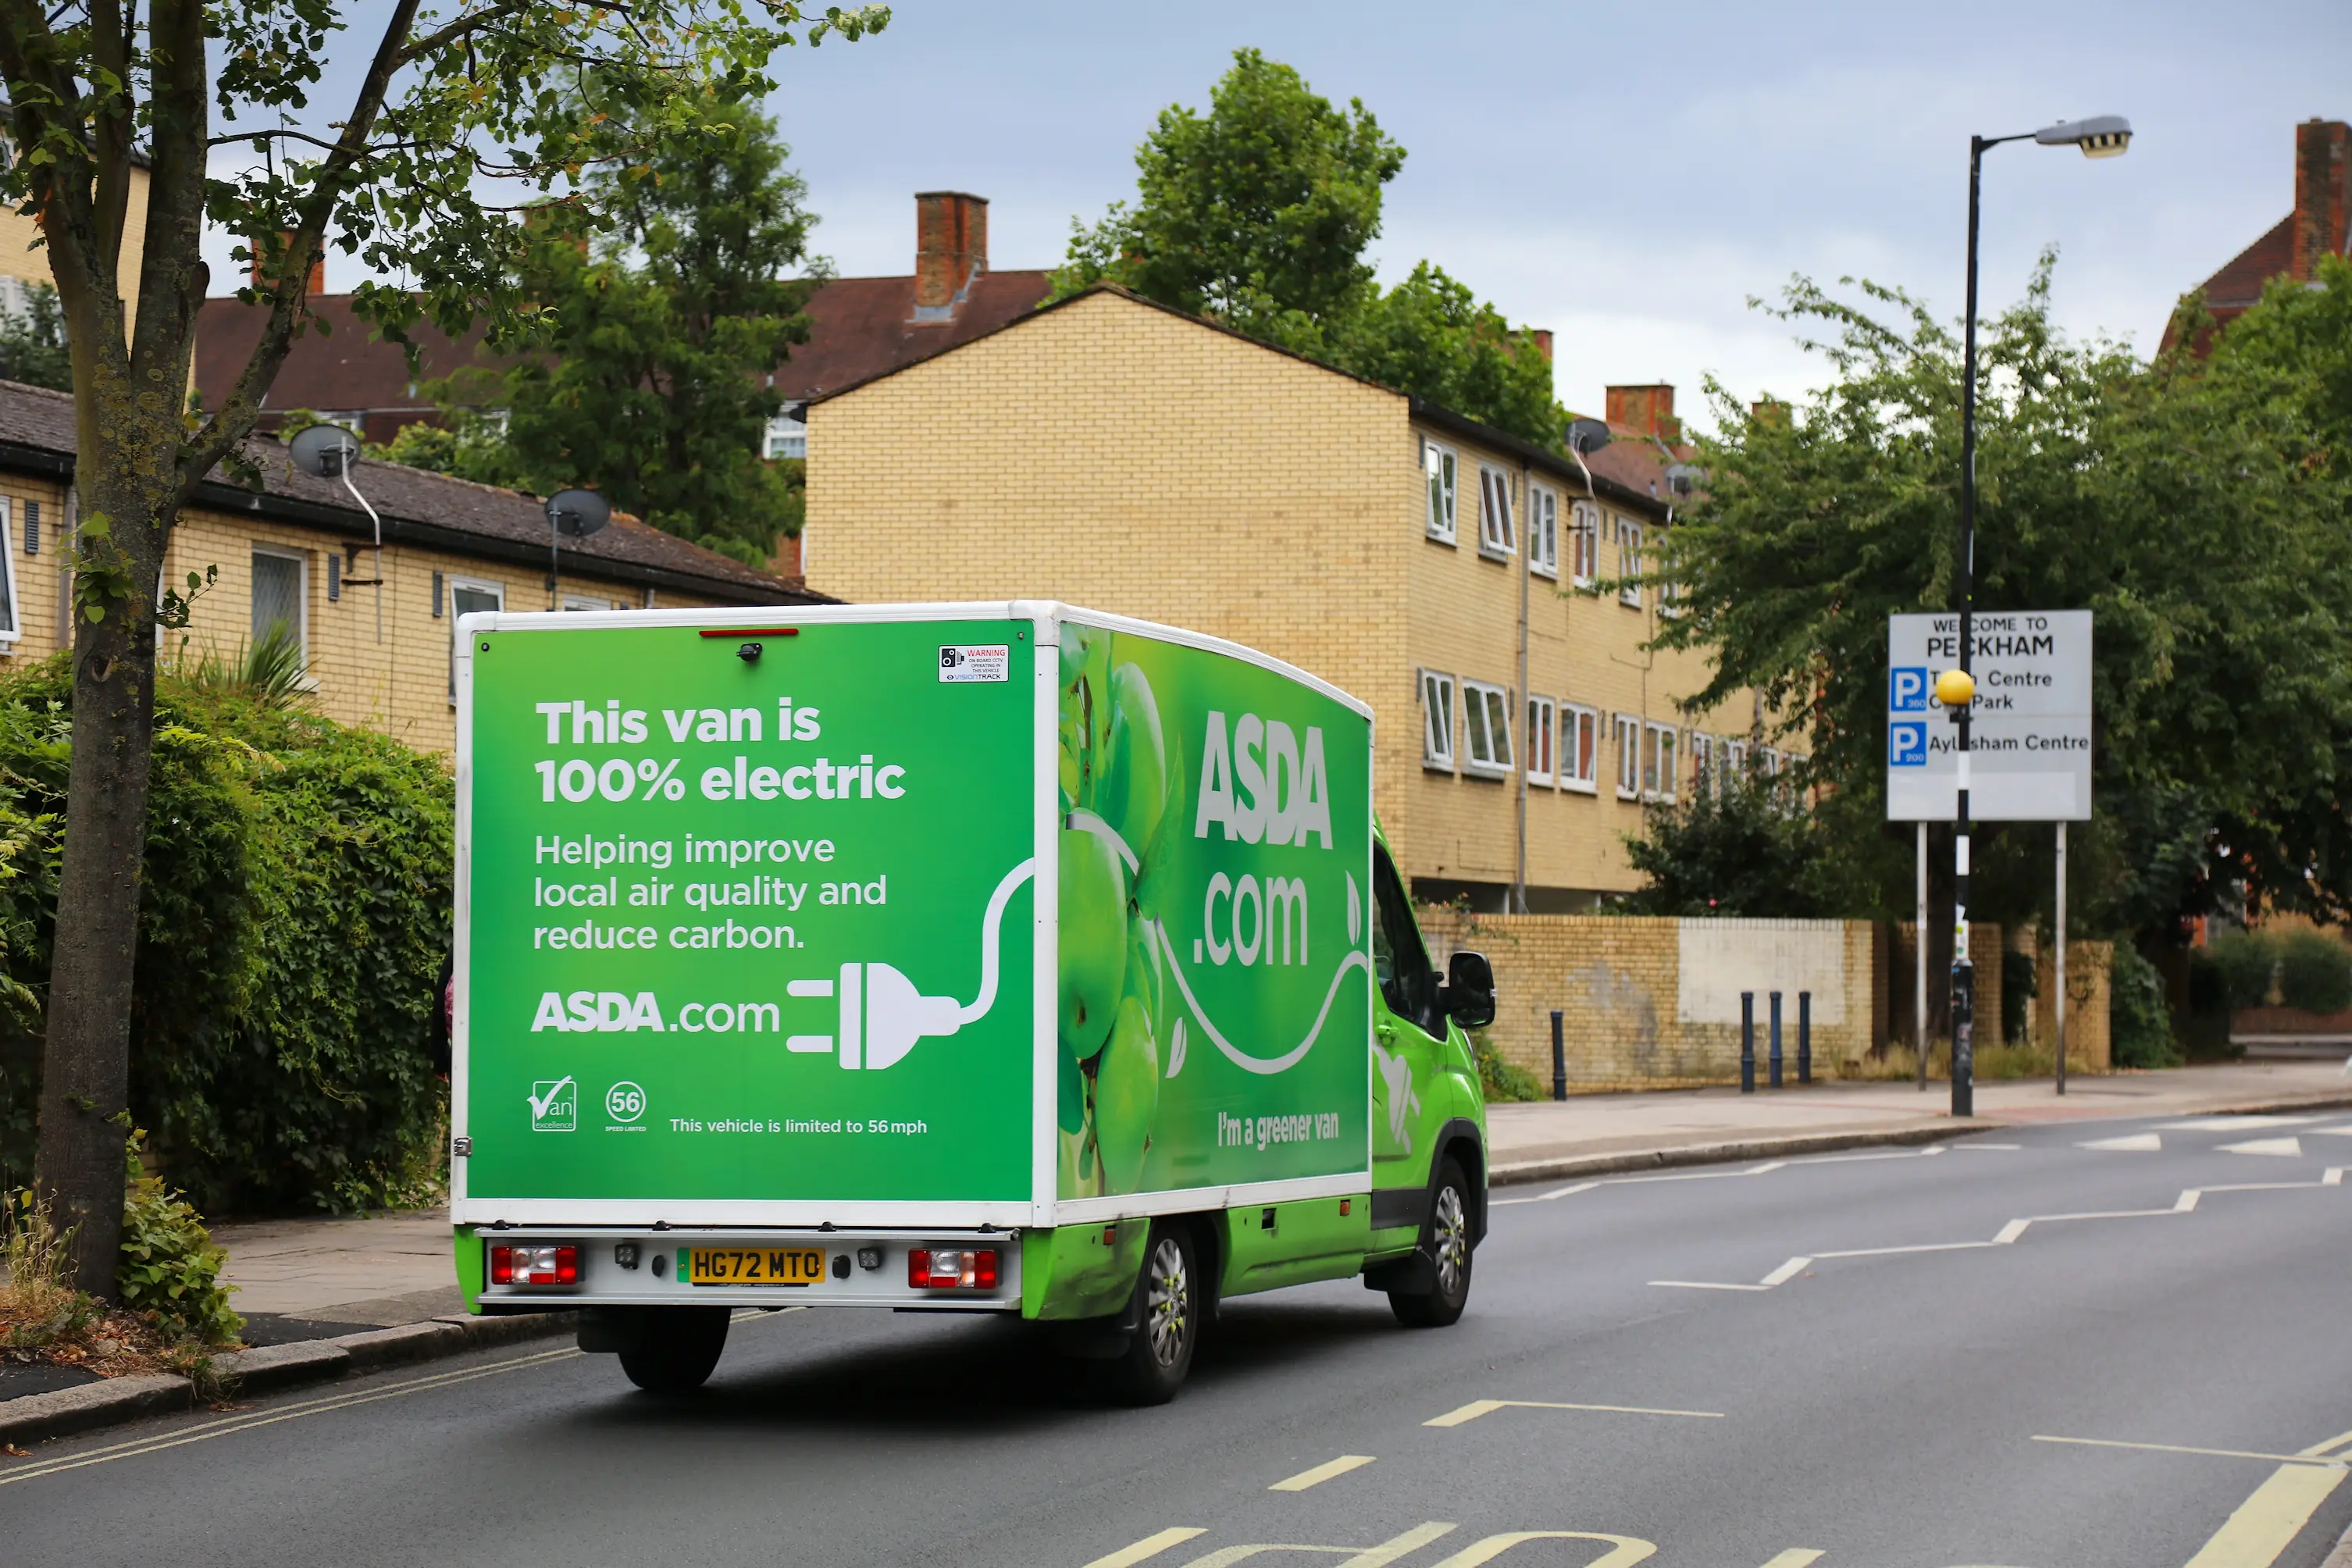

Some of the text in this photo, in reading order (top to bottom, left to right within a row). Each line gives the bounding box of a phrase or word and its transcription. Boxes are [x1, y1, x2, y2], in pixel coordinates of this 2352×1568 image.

[1933, 616, 2048, 633] WECOME TO
[1895, 672, 1922, 707] P
[1988, 670, 2052, 687] Centre
[1972, 693, 2013, 710] Park
[536, 697, 821, 744] This van is
[1893, 726, 1919, 763] P
[1930, 734, 2089, 754] Aylsham Centre
[534, 754, 907, 803] 100% electric
[1195, 710, 1334, 850] ASDA
[536, 832, 836, 870] Helping improve
[535, 874, 886, 912] local air quality and
[534, 918, 804, 950] reduce carbon.
[1194, 871, 1308, 967] .com
[530, 990, 780, 1033] ASDA.com
[611, 1091, 641, 1114] 56
[670, 1118, 703, 1132] This
[707, 1118, 764, 1133] vehicle
[768, 1119, 781, 1132] is
[786, 1119, 842, 1133] limited
[846, 1120, 864, 1134] to
[1218, 1112, 1339, 1152] I'm a greener van
[694, 1252, 820, 1278] HG72 MTO
